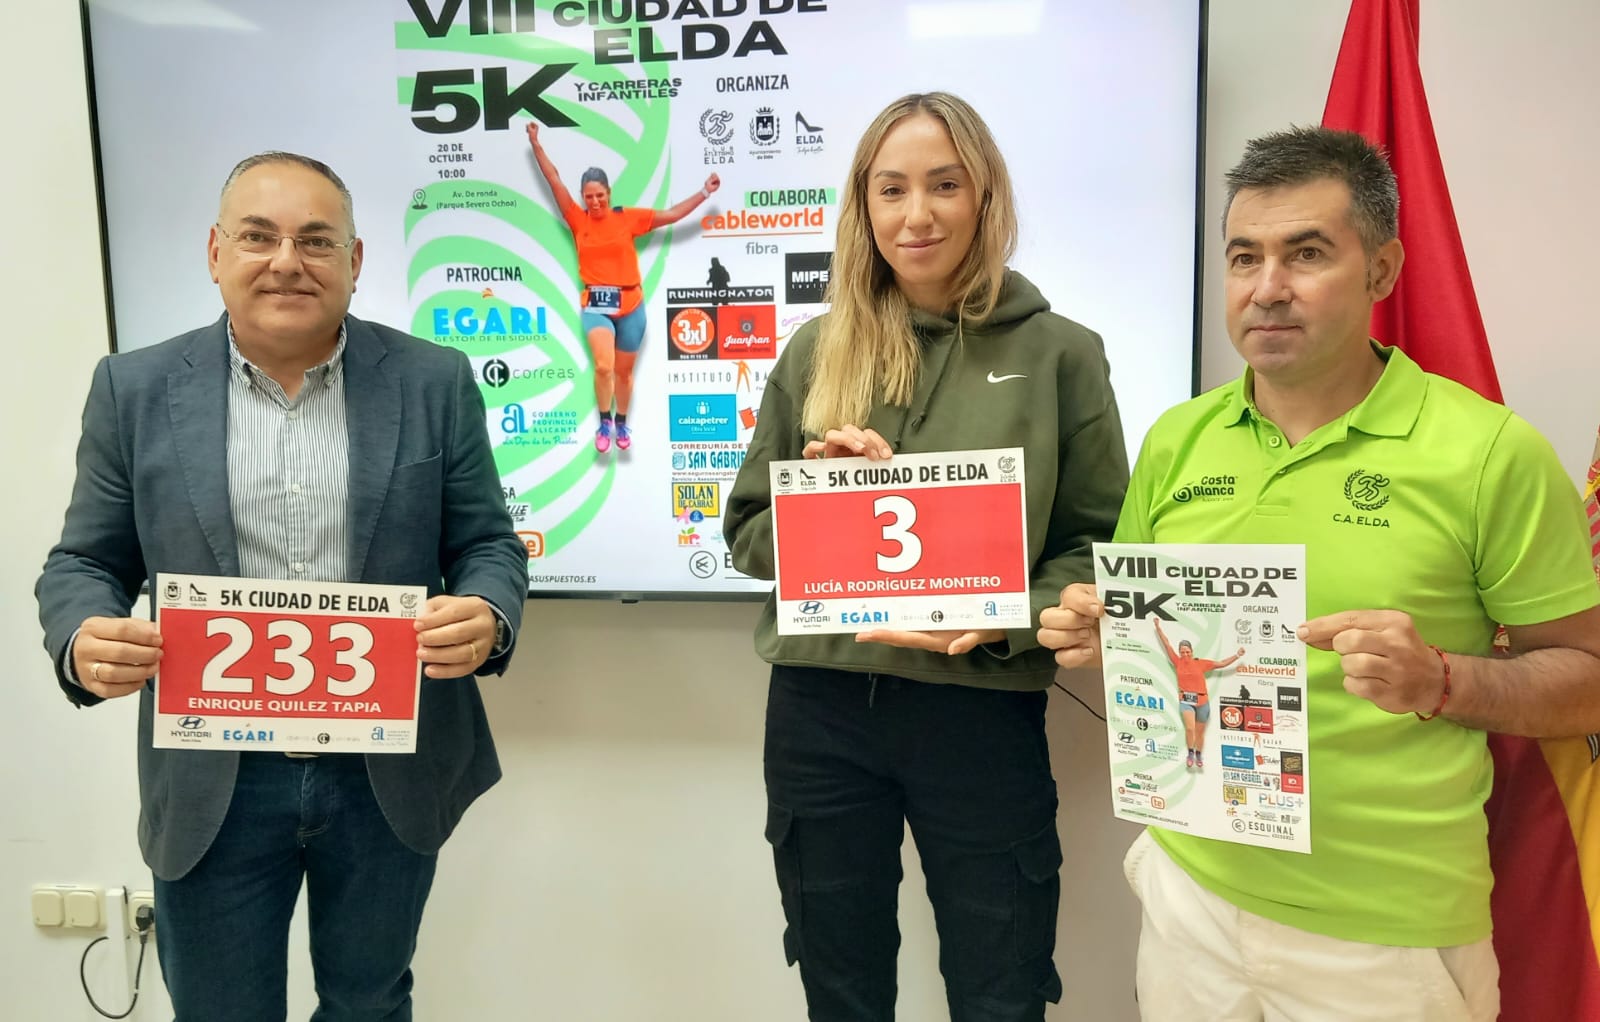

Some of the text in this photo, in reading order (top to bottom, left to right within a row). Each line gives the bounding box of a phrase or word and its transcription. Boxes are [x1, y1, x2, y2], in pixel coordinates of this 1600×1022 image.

[407, 0, 535, 38] VIII
[553, 0, 746, 27] CIUDAD
[594, 20, 788, 64] ELDA
[574, 78, 682, 91] Y CARRERAS
[716, 74, 789, 93] ORGANIZA
[411, 63, 581, 134] 5K
[578, 88, 678, 102] INFANTILES
[796, 135, 824, 144] ELDA
[437, 143, 463, 152] 20 DE
[429, 153, 473, 163] OCTUBRE
[438, 169, 465, 179] 10:00
[452, 190, 498, 198] Av. De ronda
[750, 189, 827, 207] COLABORA
[436, 200, 517, 210] (Parque Severo Ochoa)
[701, 207, 823, 230] cableworld
[745, 242, 779, 254] fibra
[447, 266, 523, 283] PATROCINA
[792, 270, 829, 283] MIPE
[668, 288, 773, 299] RUNNINGNATOR
[433, 306, 547, 336] EGARI
[678, 319, 707, 346] 3x1
[723, 334, 770, 348] Juanfran
[513, 366, 575, 379] correas
[668, 372, 732, 383] INSTITUTO
[678, 416, 729, 426] caixapetrer
[688, 450, 746, 469] SAN GABRIE
[828, 469, 849, 488] 5K
[854, 467, 913, 486] CIUDAD
[919, 465, 941, 483] DE
[947, 462, 989, 481] ELDA
[1201, 475, 1235, 485] Costa
[1193, 486, 1234, 496] Blanca
[1333, 513, 1391, 528] C.A. ELDA
[873, 495, 923, 573] 3
[1099, 556, 1298, 580] VIII CIUDAD DE
[529, 575, 597, 583] ASUSPUESTOS.ES
[804, 576, 1001, 594] LUCÍA RODRÍGUEZ MONTERO
[1184, 580, 1278, 598] ELDA
[220, 589, 389, 613] 5K CIUDAD DE ELDA
[1104, 589, 1178, 622] 5K
[1243, 605, 1279, 614] ORGANIZA
[841, 611, 889, 624] EGARI
[201, 616, 376, 697] 233
[1259, 657, 1298, 667] COLABORA
[1236, 664, 1296, 676] cableworld
[1120, 674, 1153, 686] PATROCINA
[188, 697, 382, 713] ENRIQUE QUILEZ TAPIA
[1116, 690, 1164, 711] EGARI
[170, 730, 212, 738] HYUNDAI
[223, 730, 274, 741] EGARI
[1248, 821, 1294, 836] ESQUINAL
